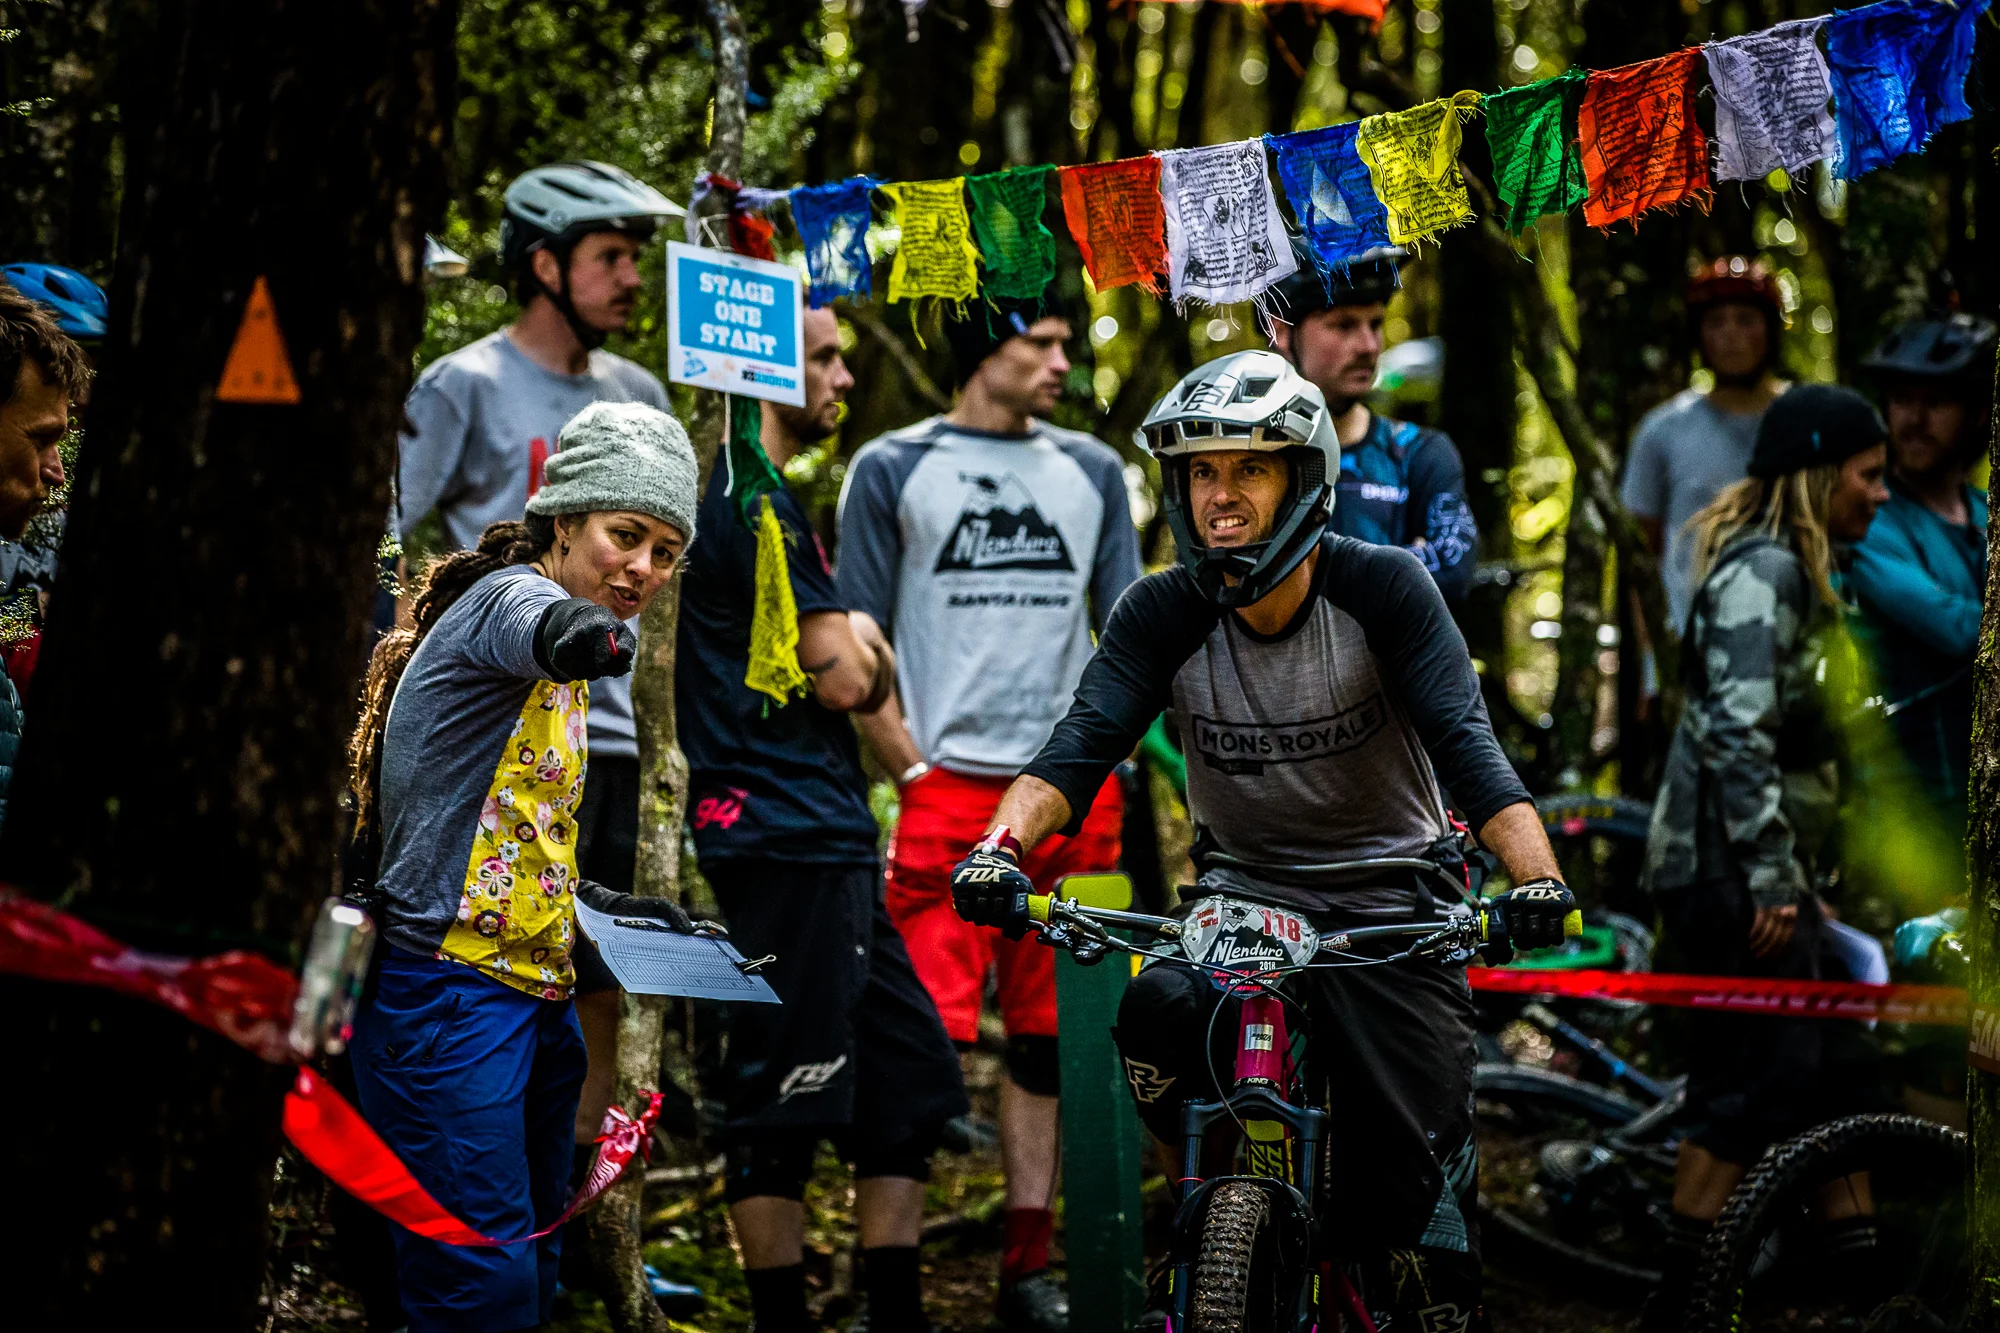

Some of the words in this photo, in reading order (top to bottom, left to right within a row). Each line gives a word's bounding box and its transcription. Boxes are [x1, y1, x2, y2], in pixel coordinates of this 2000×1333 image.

[699, 271, 775, 307] STAGE
[714, 299, 762, 329] ONE
[699, 322, 777, 357] START
[1202, 727, 1273, 755] MONS
[1277, 708, 1377, 753] ROYALE
[954, 867, 1010, 884] FOX
[1510, 887, 1564, 901] FOX
[1260, 908, 1301, 943] 118
[1211, 936, 1285, 967] NZenduro
[1259, 961, 1277, 972] 2018
[1246, 1077, 1269, 1085] KING
